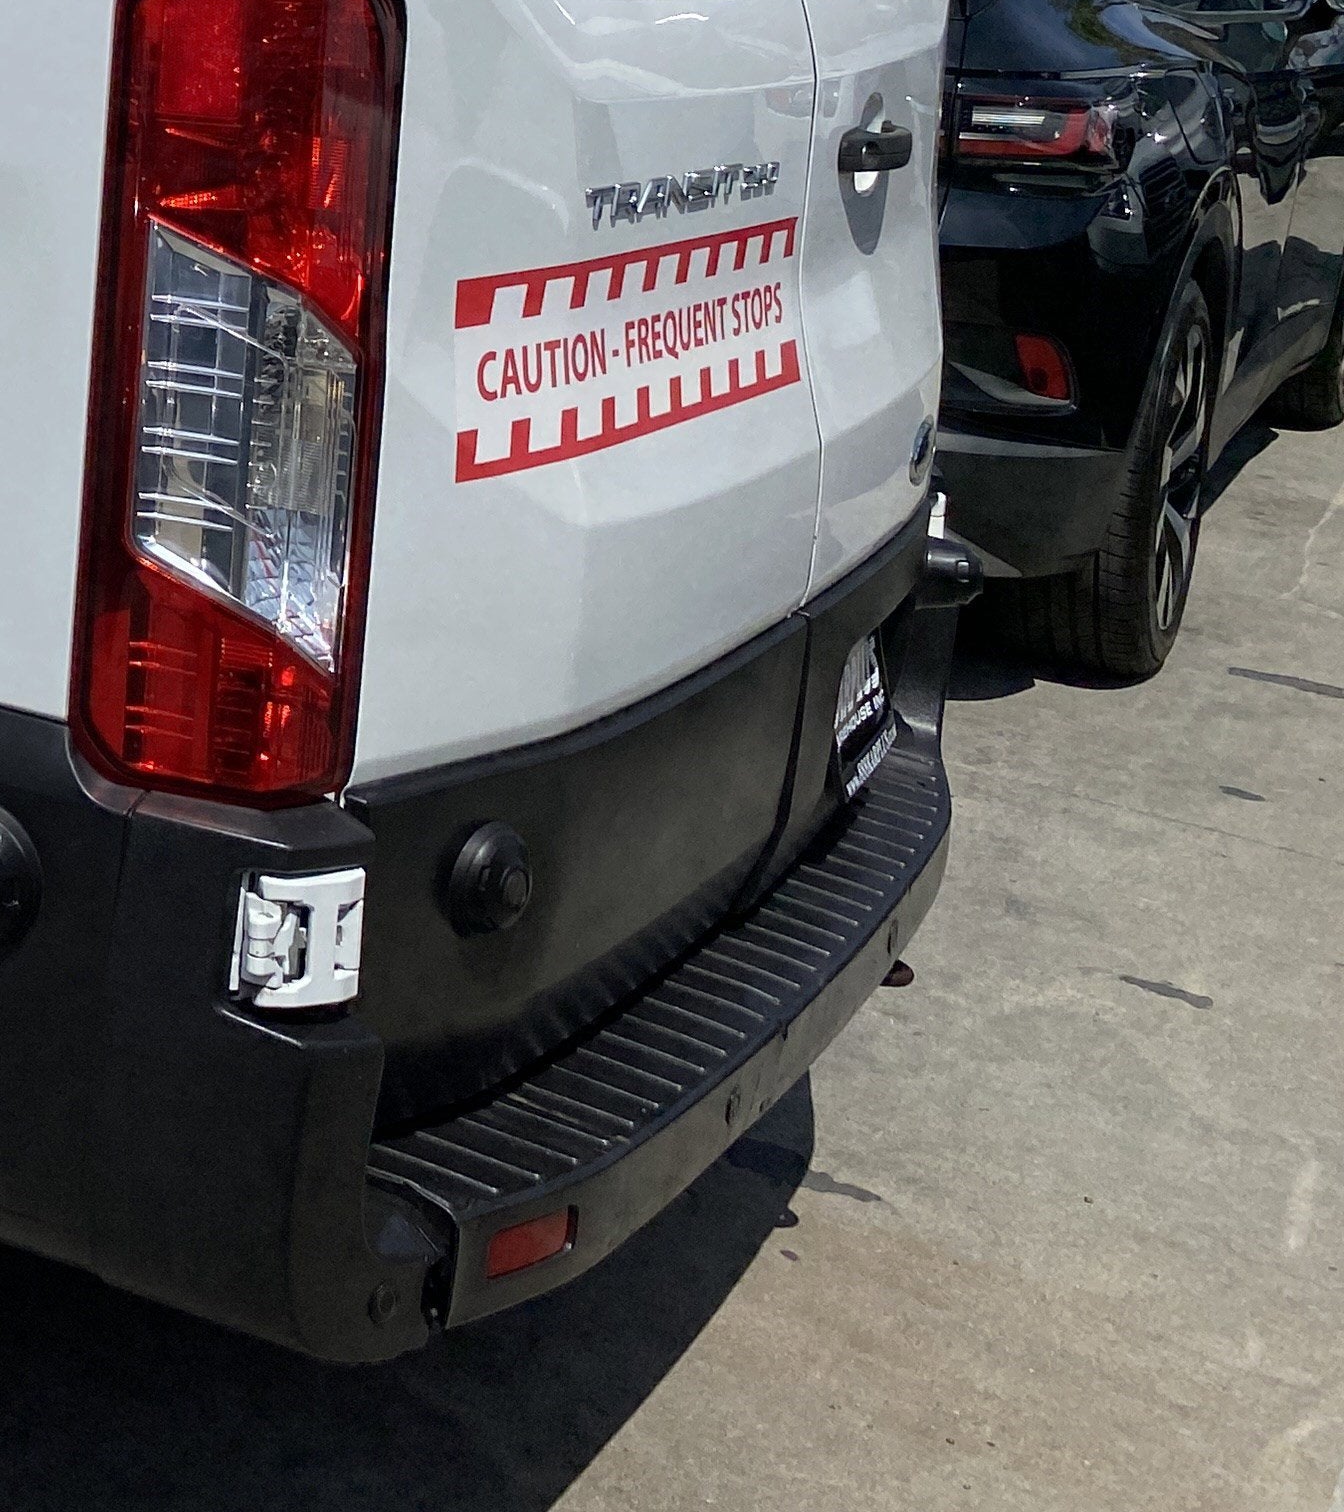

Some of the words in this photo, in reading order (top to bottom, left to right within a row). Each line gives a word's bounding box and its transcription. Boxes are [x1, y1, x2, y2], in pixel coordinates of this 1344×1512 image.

[585, 163, 743, 222] TRANSIT
[476, 328, 608, 402] CAUTION
[624, 295, 728, 369] FREQUENT
[731, 281, 783, 337] STOPS
